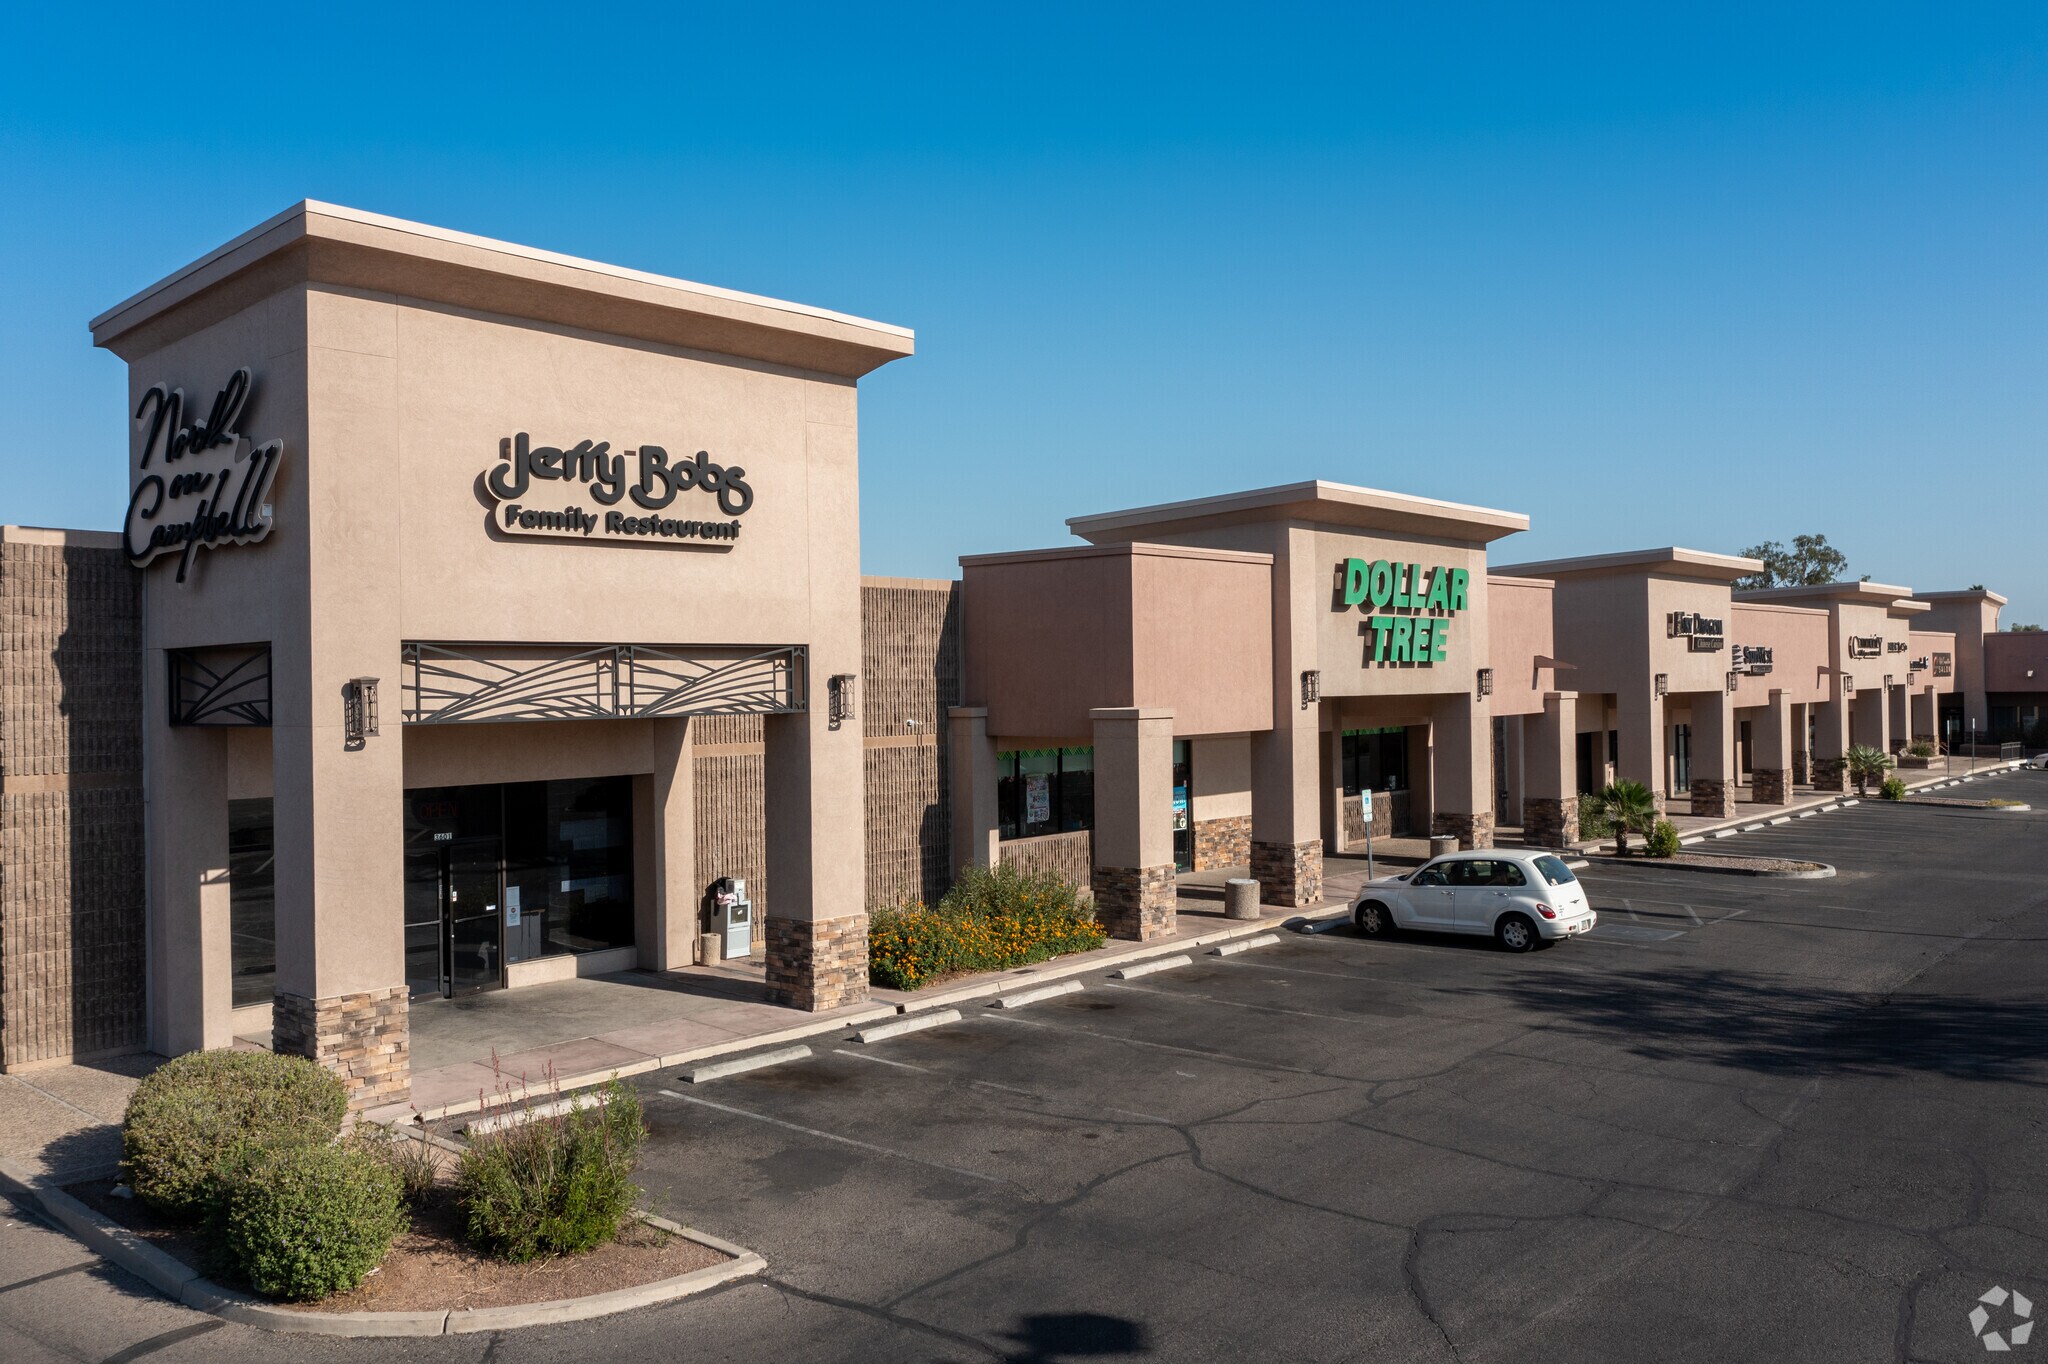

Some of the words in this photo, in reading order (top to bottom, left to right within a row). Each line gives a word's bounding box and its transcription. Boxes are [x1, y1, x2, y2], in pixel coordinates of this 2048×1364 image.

[489, 432, 625, 505] Jerry
[629, 445, 754, 516] Bobs
[123, 445, 275, 584] Campbell
[505, 504, 598, 536] Family
[605, 510, 741, 541] Restaurant
[1343, 557, 1470, 611] DOLLAR
[1368, 615, 1449, 662] TREE
